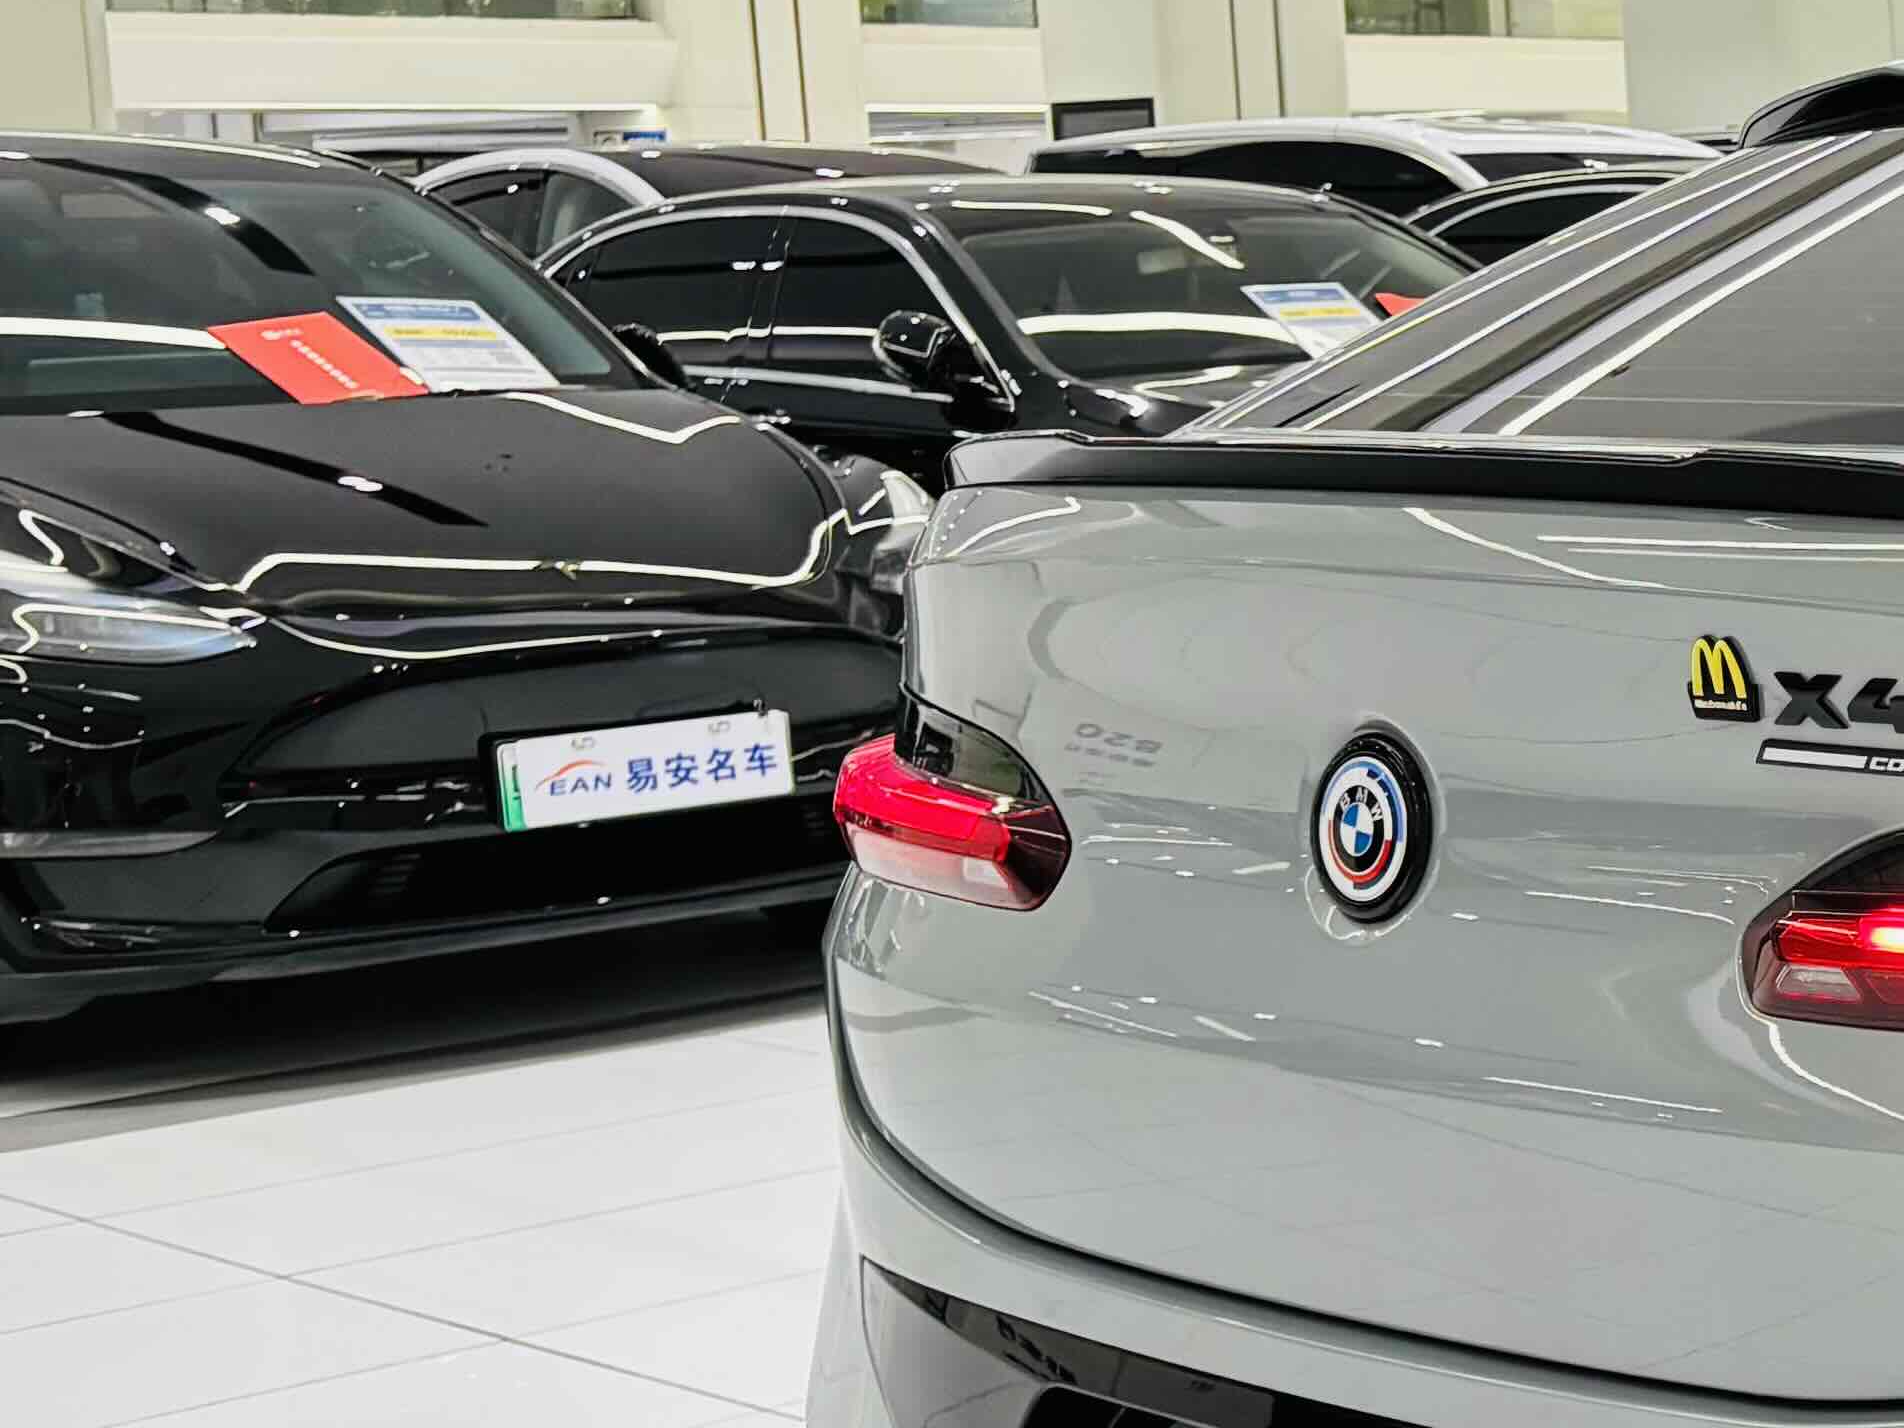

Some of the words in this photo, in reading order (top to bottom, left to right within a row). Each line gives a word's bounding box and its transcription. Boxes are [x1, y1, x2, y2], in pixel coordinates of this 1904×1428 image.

[549, 773, 613, 797] EAN
[626, 742, 779, 794] 易安名车
[1339, 786, 1384, 822] BMW
